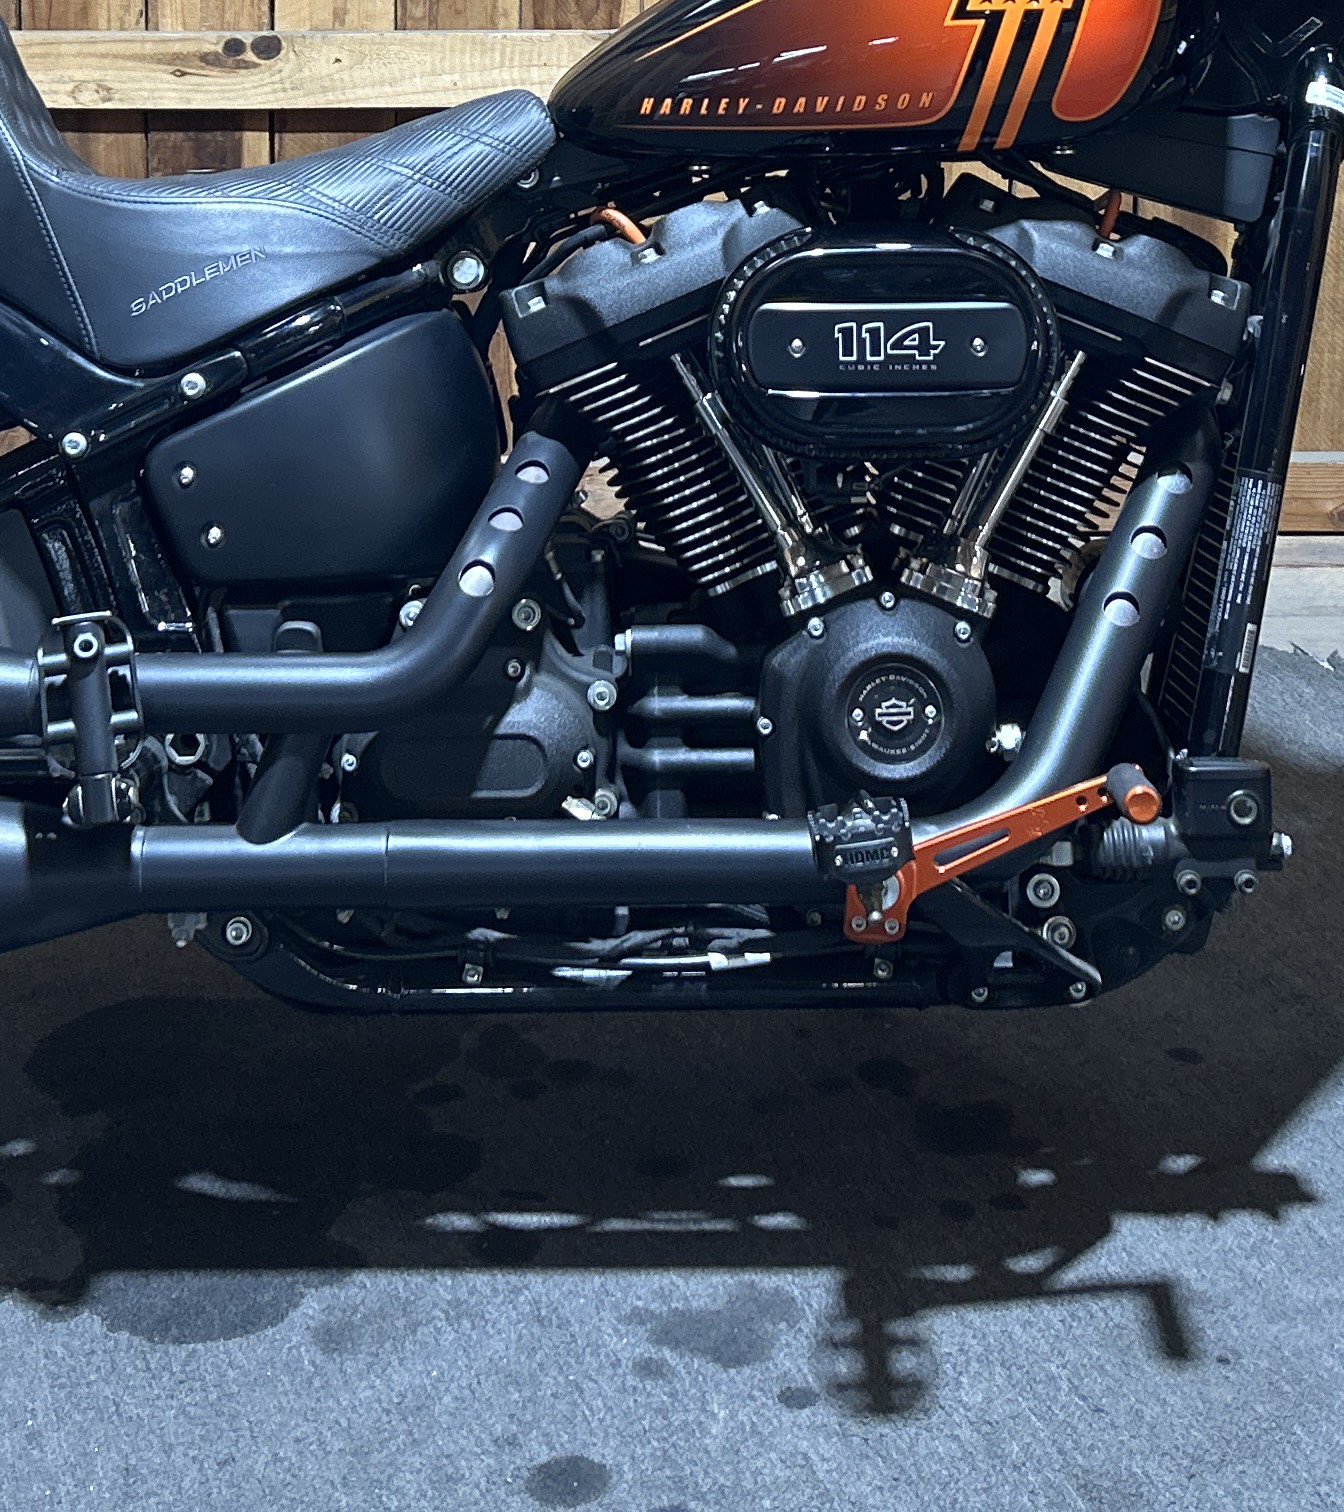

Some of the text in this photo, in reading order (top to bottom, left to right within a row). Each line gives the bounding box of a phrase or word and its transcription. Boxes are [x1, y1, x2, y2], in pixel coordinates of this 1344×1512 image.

[639, 91, 936, 116] HARLEY-DAVIDSON
[129, 245, 267, 317] SADDLEMEN
[834, 320, 946, 361] 114
